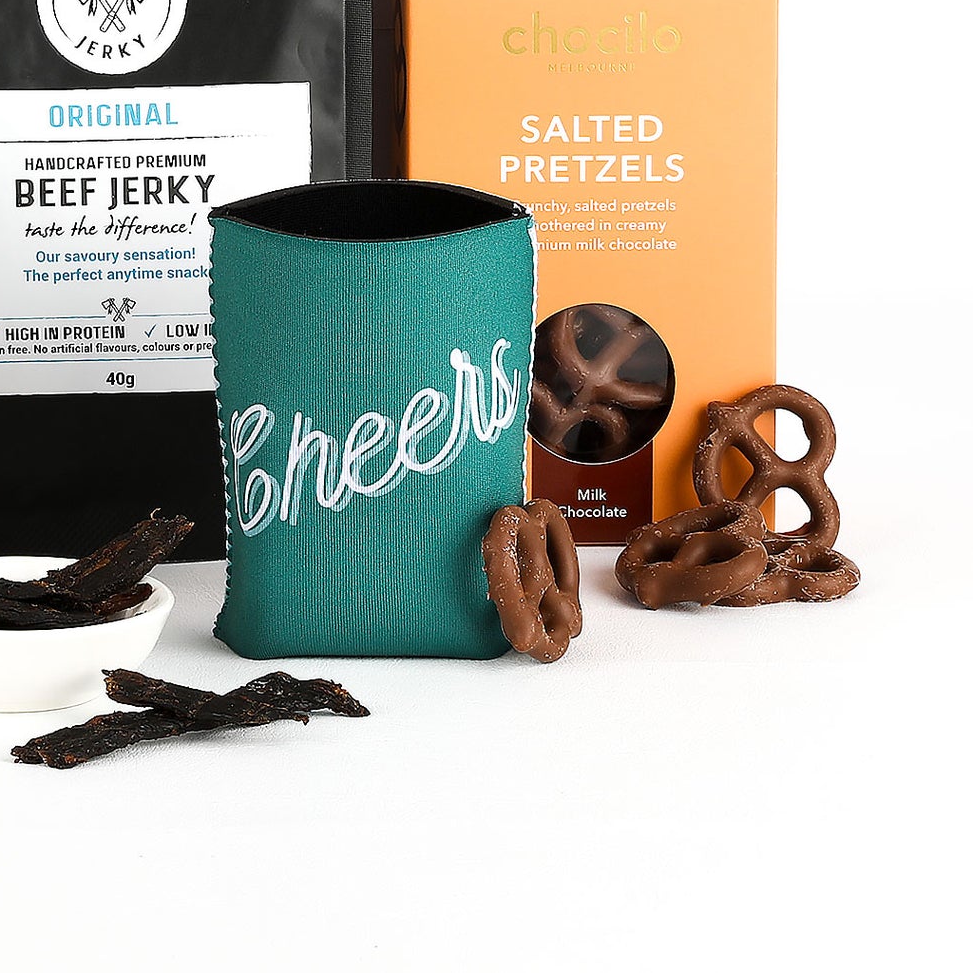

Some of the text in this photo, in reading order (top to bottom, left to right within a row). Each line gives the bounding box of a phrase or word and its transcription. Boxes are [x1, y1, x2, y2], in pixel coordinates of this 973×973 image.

[502, 10, 683, 55] chocilo
[74, 34, 146, 59] JERKY
[548, 63, 635, 72] MELBOURNE
[49, 102, 178, 127] ORIGINAL
[520, 114, 663, 143] SALTED
[25, 154, 206, 171] HANDCRAFTED PREMIUM
[500, 154, 685, 183] PRETZELS
[15, 174, 215, 209] BEEF JERKY
[525, 198, 676, 214] unchy, salted pretzels
[25, 212, 197, 241] taste the difference!
[534, 218, 666, 233] othered in creamy
[576, 238, 605, 250] milk
[608, 238, 677, 250] chocolate
[36, 247, 195, 266] Our savoury sensation!
[23, 265, 208, 284] The perfect anytime snack
[5, 326, 125, 341] HIGH IN PROTEIN
[166, 324, 200, 337] LOW
[8, 344, 31, 354] free.
[33, 344, 48, 354] No
[51, 343, 93, 354] artificial
[96, 342, 140, 353] flavours,
[142, 341, 180, 352] colours
[183, 343, 193, 351] or
[196, 342, 212, 352] pre
[106, 372, 135, 388] 40g
[230, 338, 521, 537] Cheers
[577, 488, 607, 501] Milk
[559, 505, 627, 518] Chocolate
